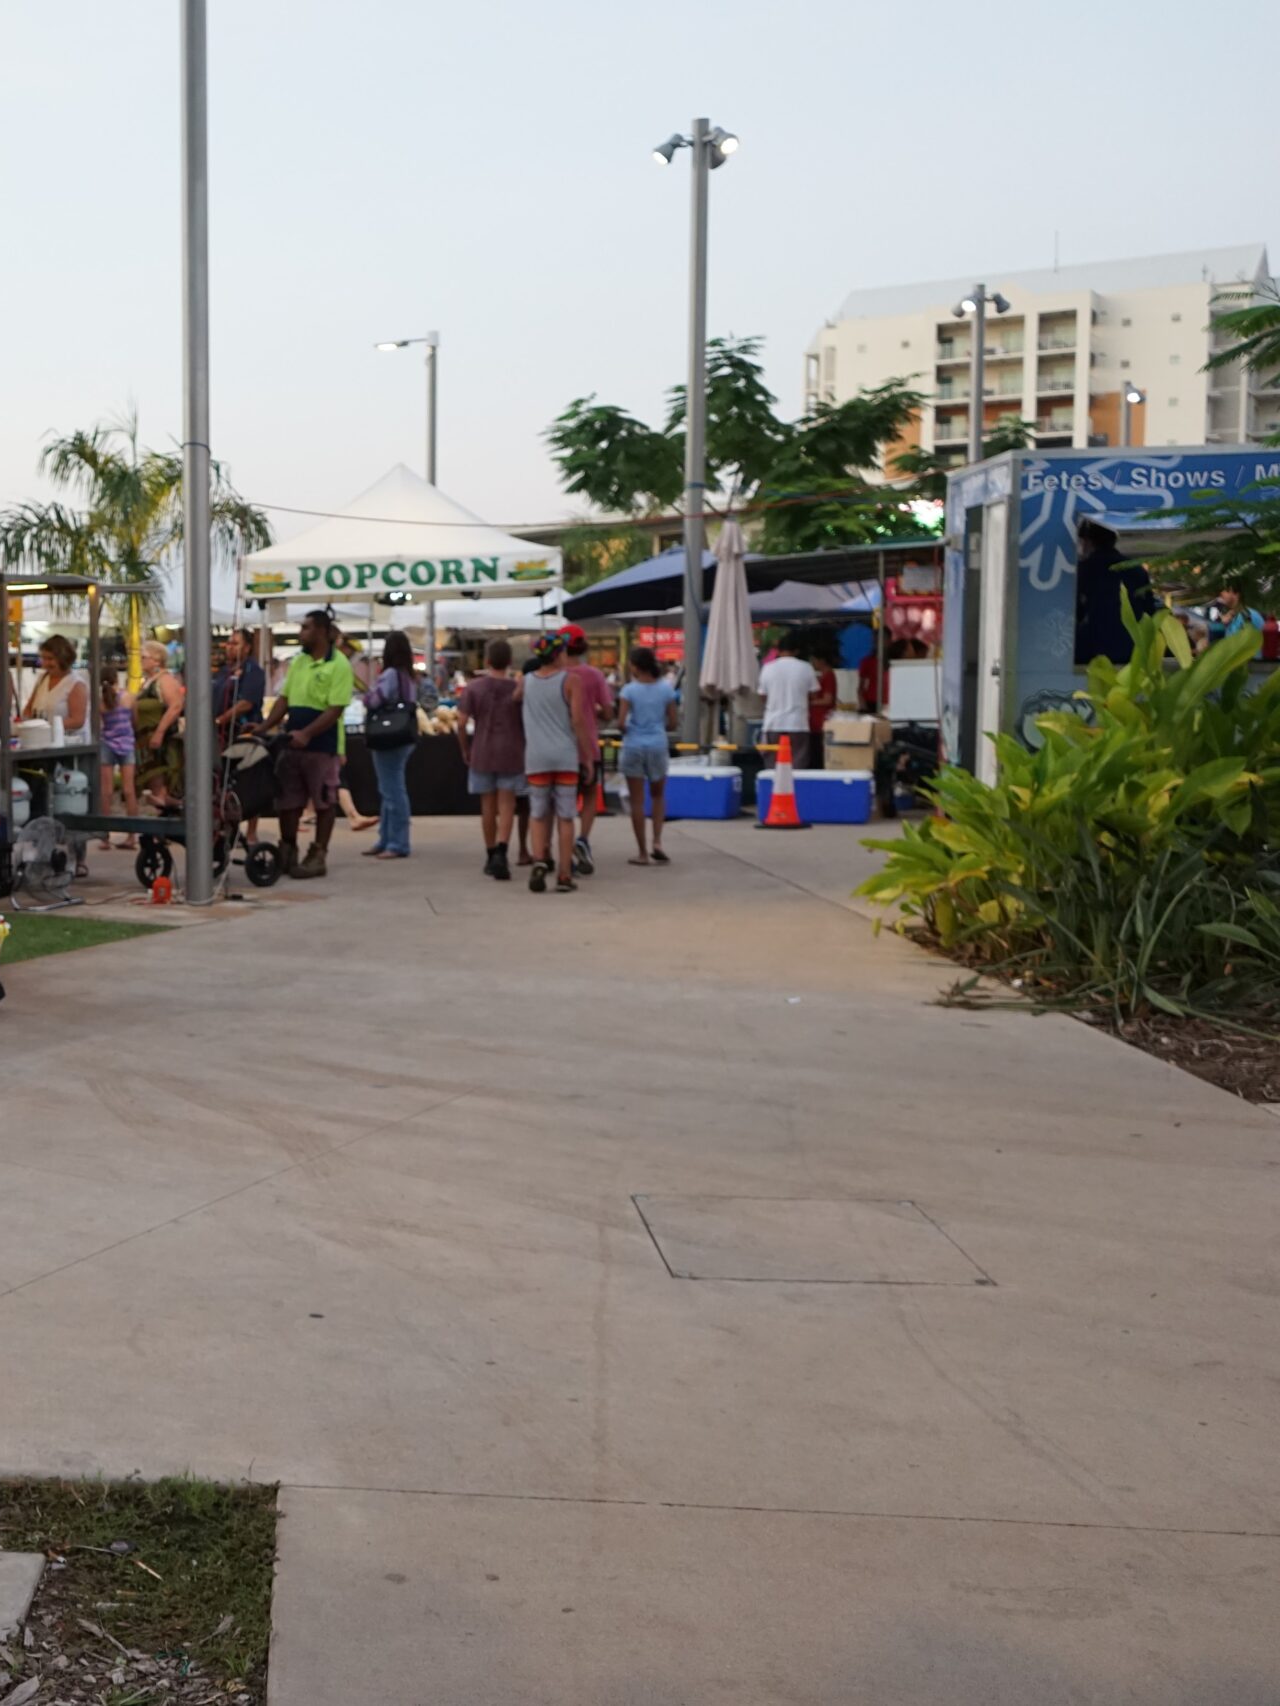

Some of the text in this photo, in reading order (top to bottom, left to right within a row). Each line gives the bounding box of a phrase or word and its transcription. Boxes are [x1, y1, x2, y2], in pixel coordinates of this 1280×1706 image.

[1027, 471, 1104, 491] Fetes
[1130, 467, 1226, 488] Shows
[1254, 463, 1280, 481] M
[297, 557, 501, 591] POPCORN
